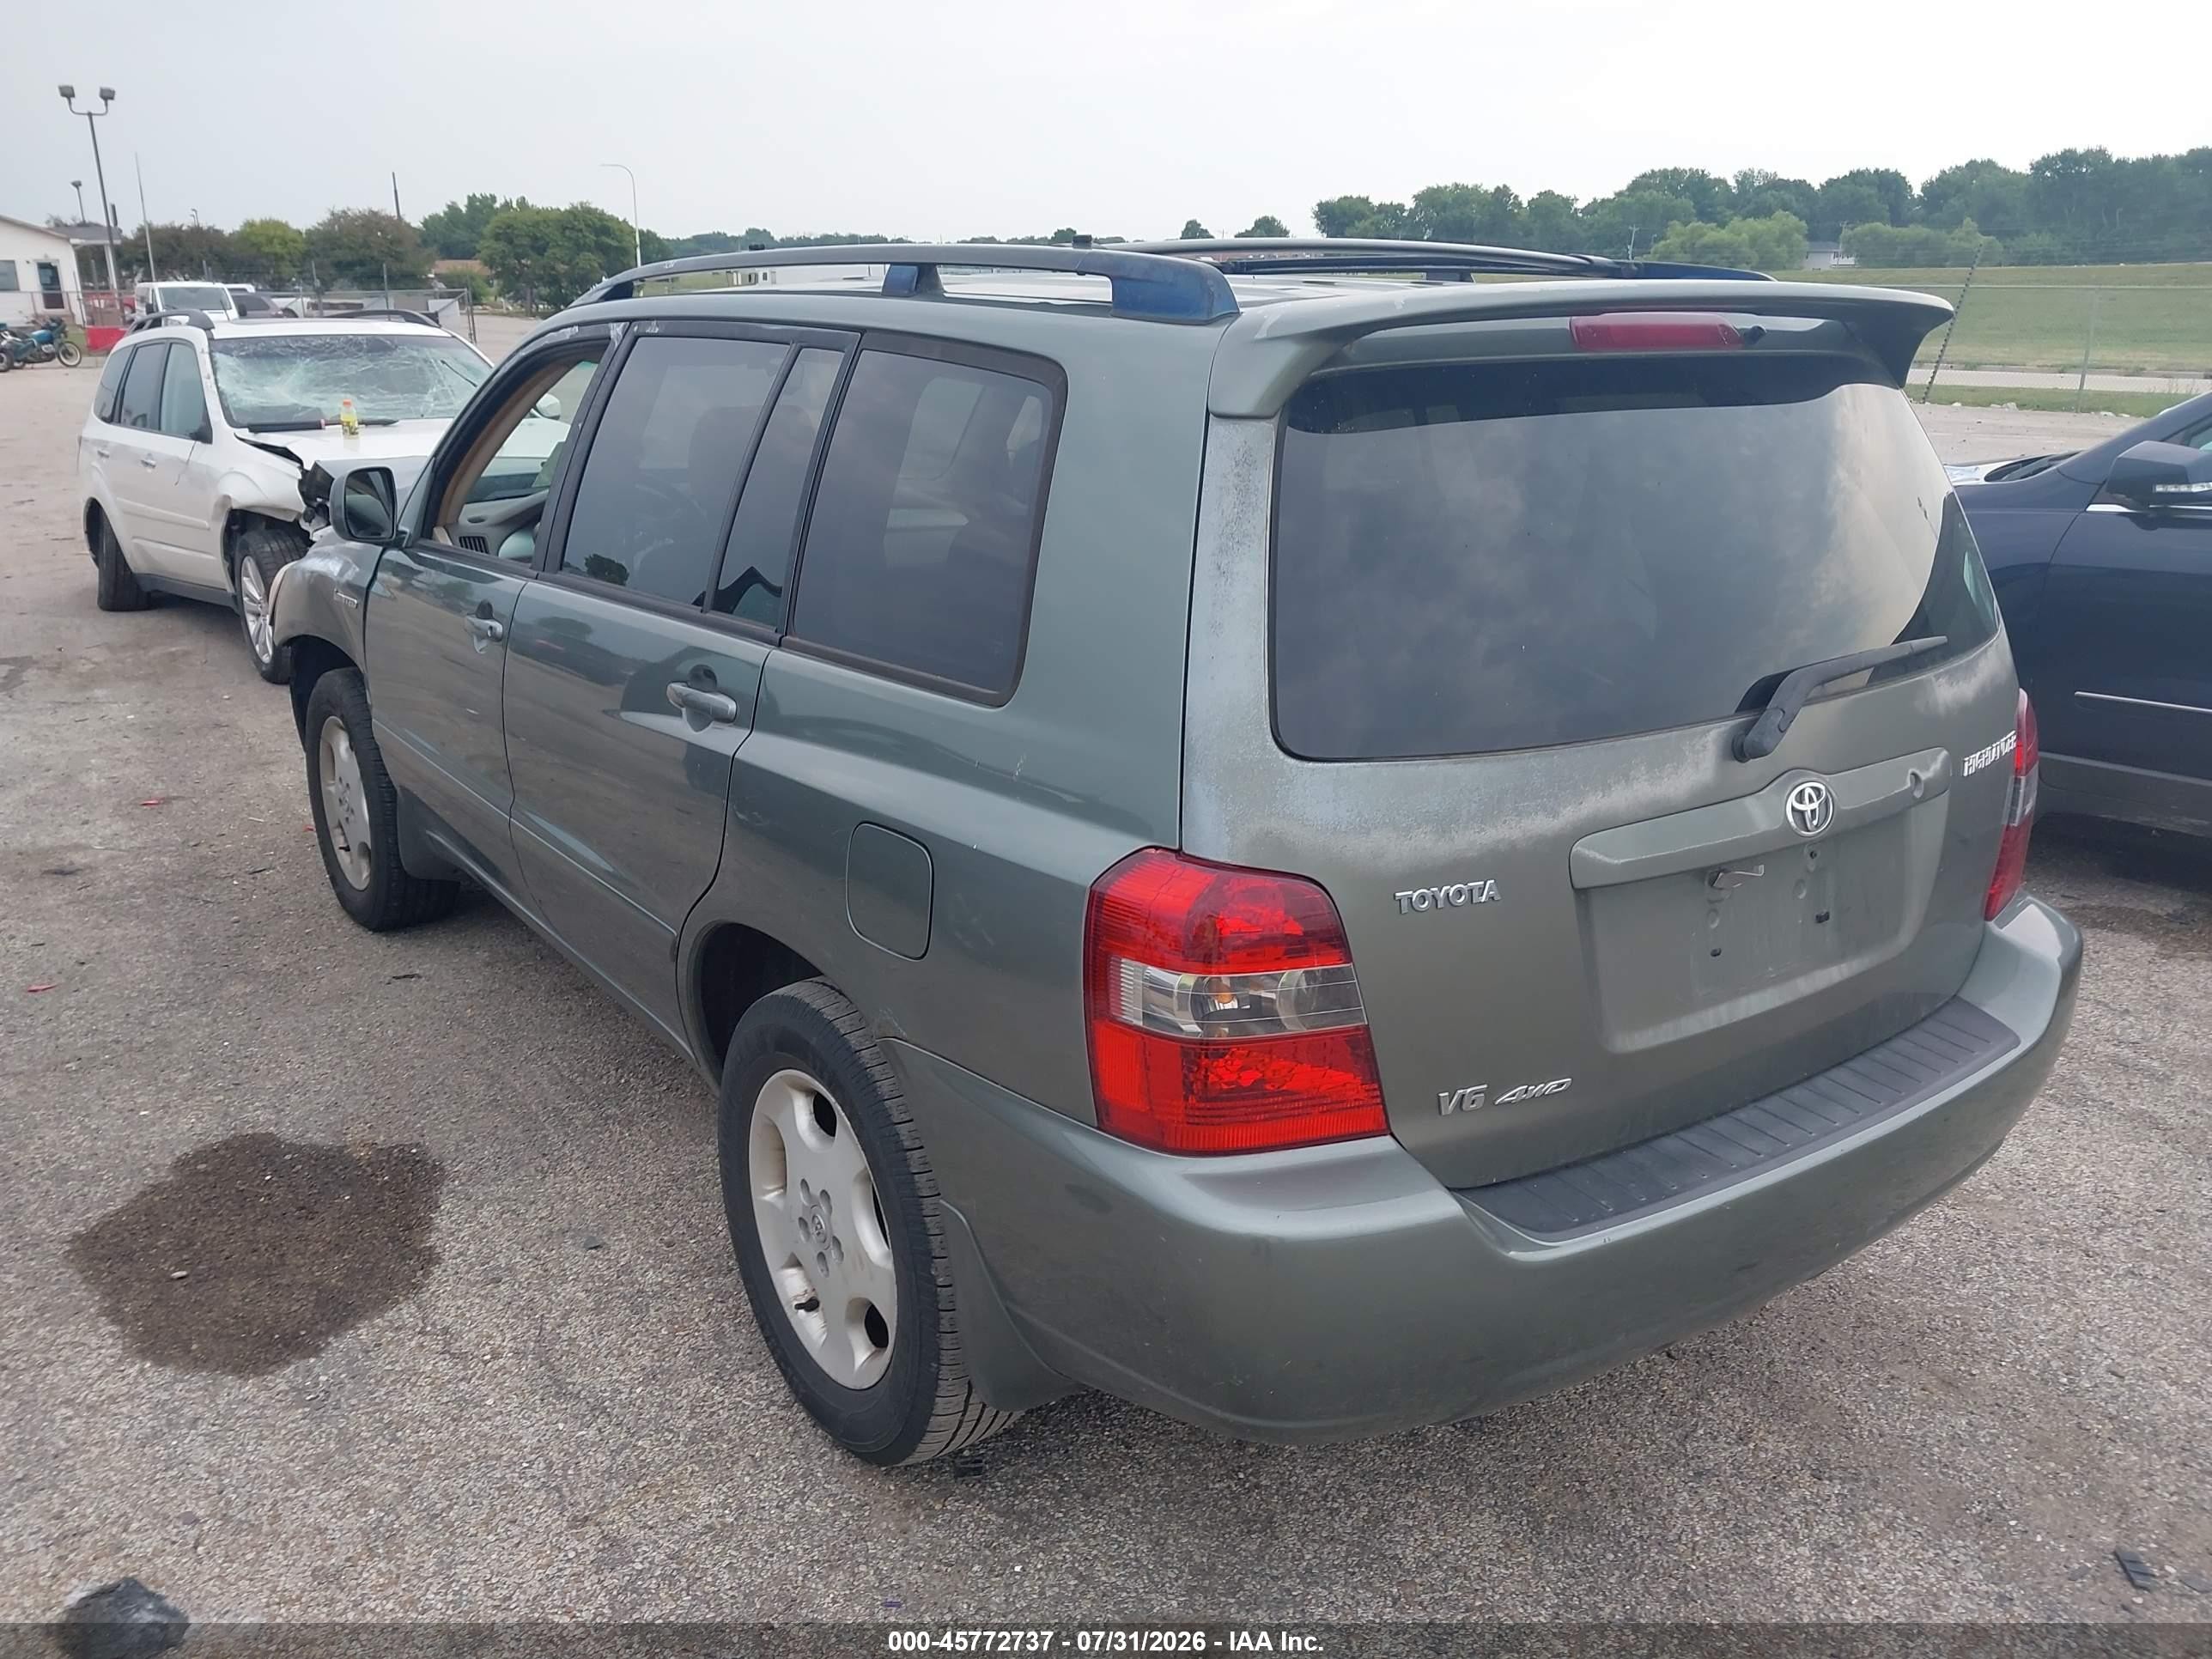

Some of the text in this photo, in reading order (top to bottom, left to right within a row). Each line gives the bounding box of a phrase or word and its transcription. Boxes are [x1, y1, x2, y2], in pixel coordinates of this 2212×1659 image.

[1394, 878, 1502, 915] TOYOTA
[1437, 1078, 1572, 1116] V6 4WD
